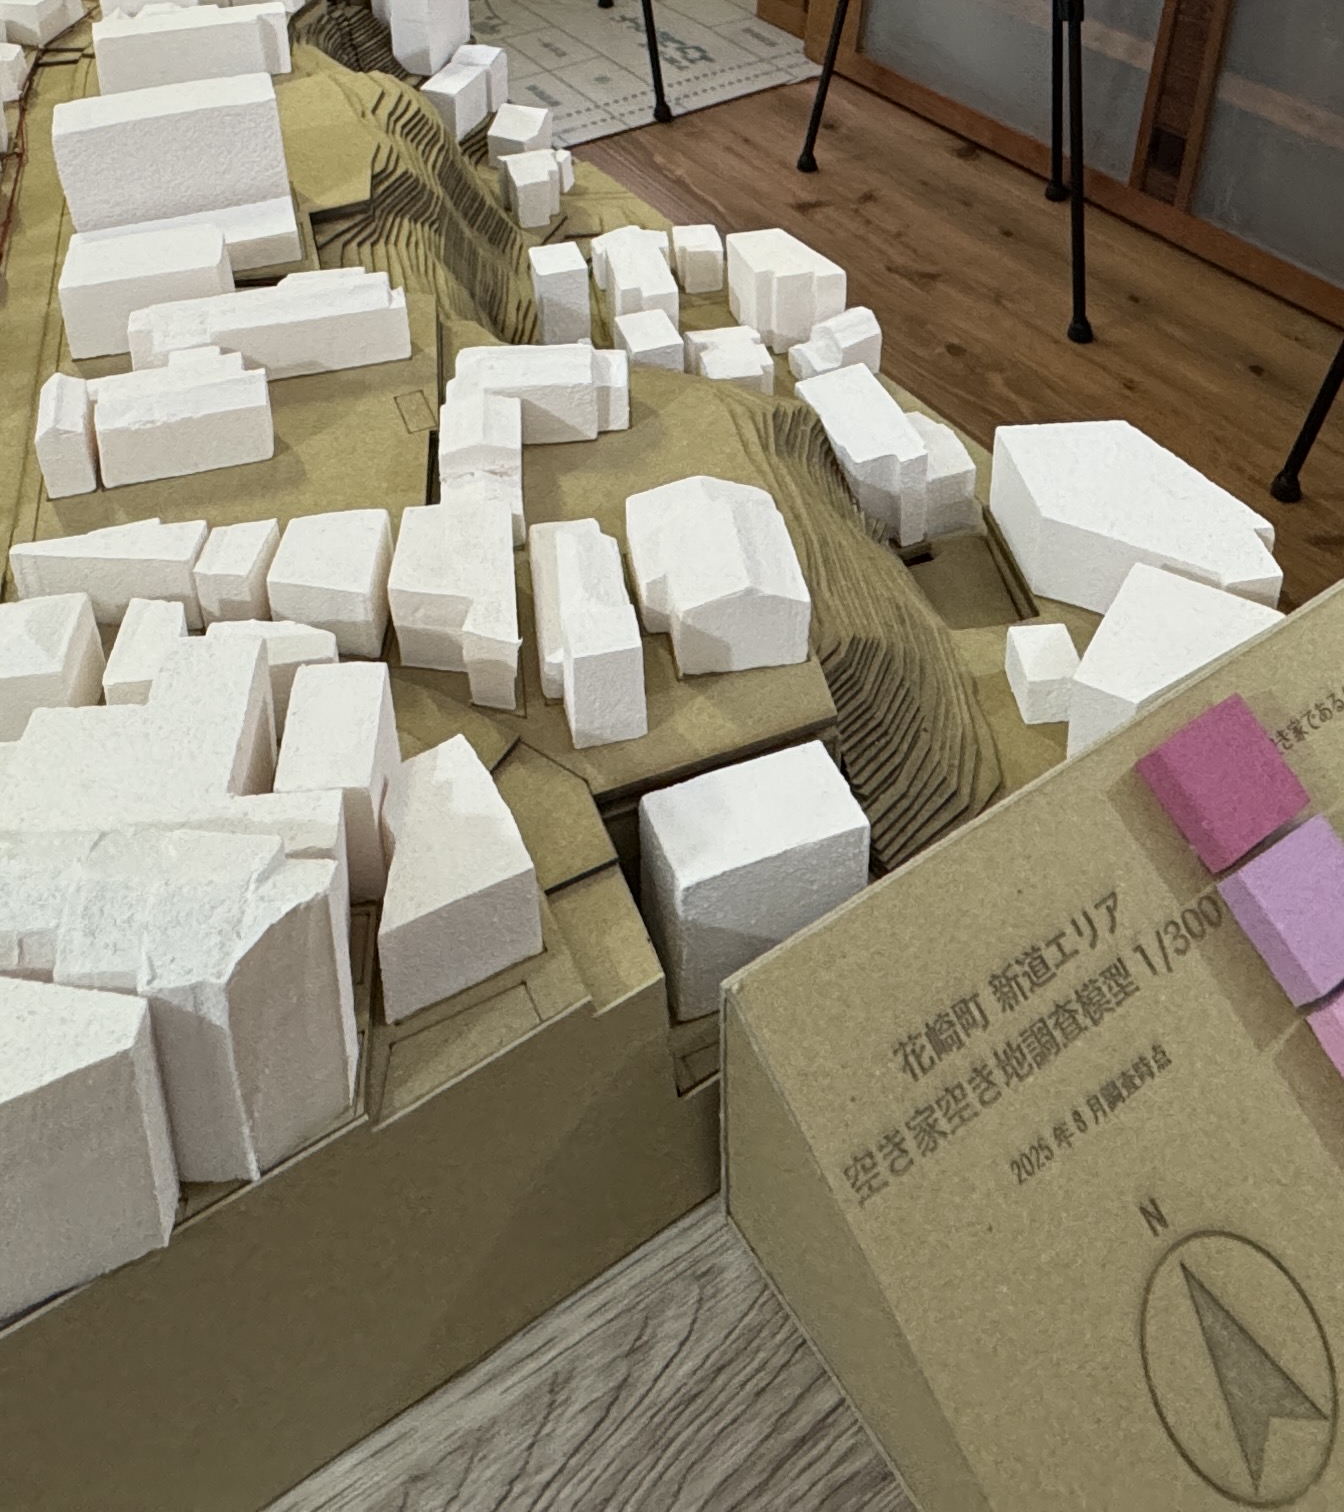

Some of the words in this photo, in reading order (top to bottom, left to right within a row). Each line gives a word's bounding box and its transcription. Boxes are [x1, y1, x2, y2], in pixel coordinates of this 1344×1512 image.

[842, 956, 1141, 1207] 空き家空き地調査模型
[1132, 892, 1224, 978] 1/300
[892, 992, 991, 1083] 花崎町
[987, 891, 1119, 1014] 新道エリア
[1138, 1197, 1170, 1236] N
